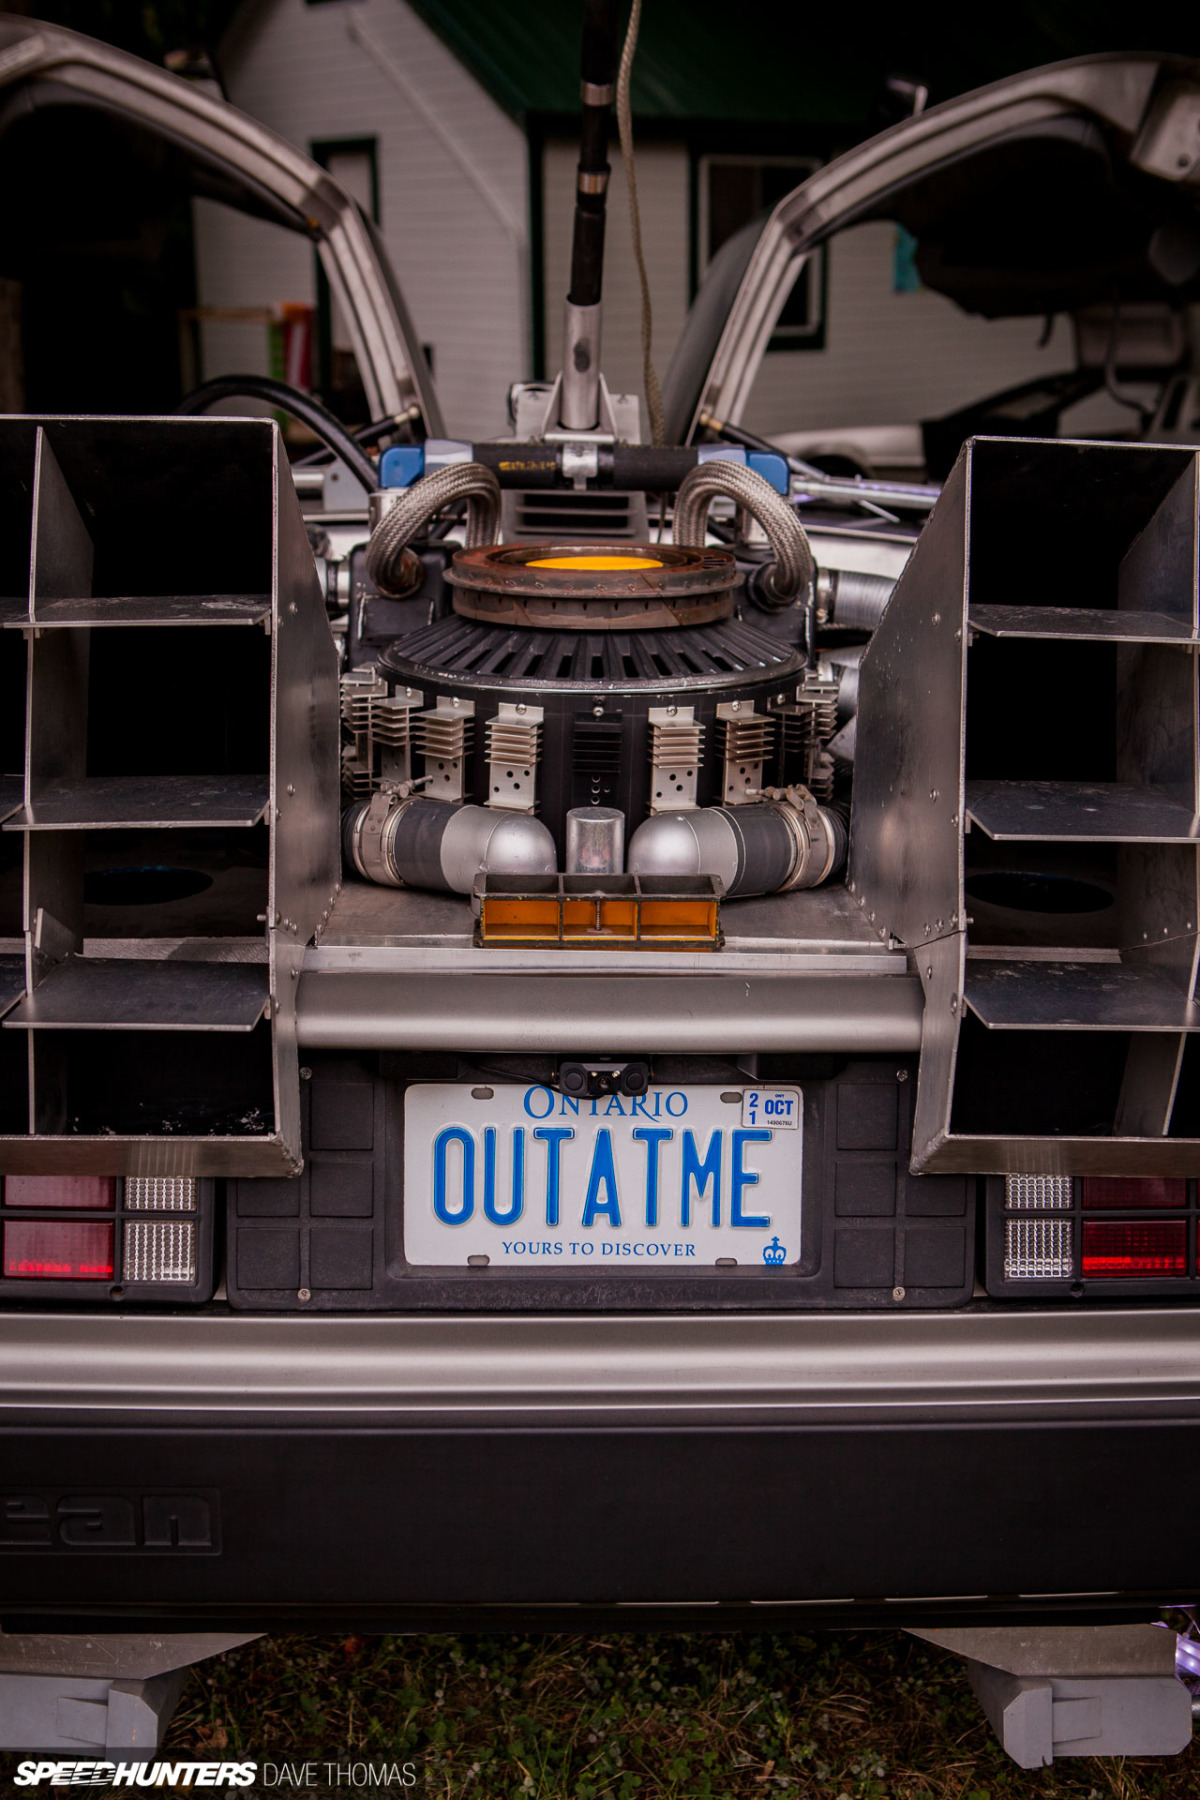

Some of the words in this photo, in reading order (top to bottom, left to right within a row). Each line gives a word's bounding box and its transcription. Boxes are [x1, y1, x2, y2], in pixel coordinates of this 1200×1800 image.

[764, 1099, 794, 1116] OCT
[433, 1126, 772, 1228] OUTATME
[502, 1241, 563, 1256] YOURS
[569, 1242, 595, 1256] TO
[601, 1242, 696, 1257] DISCOVER
